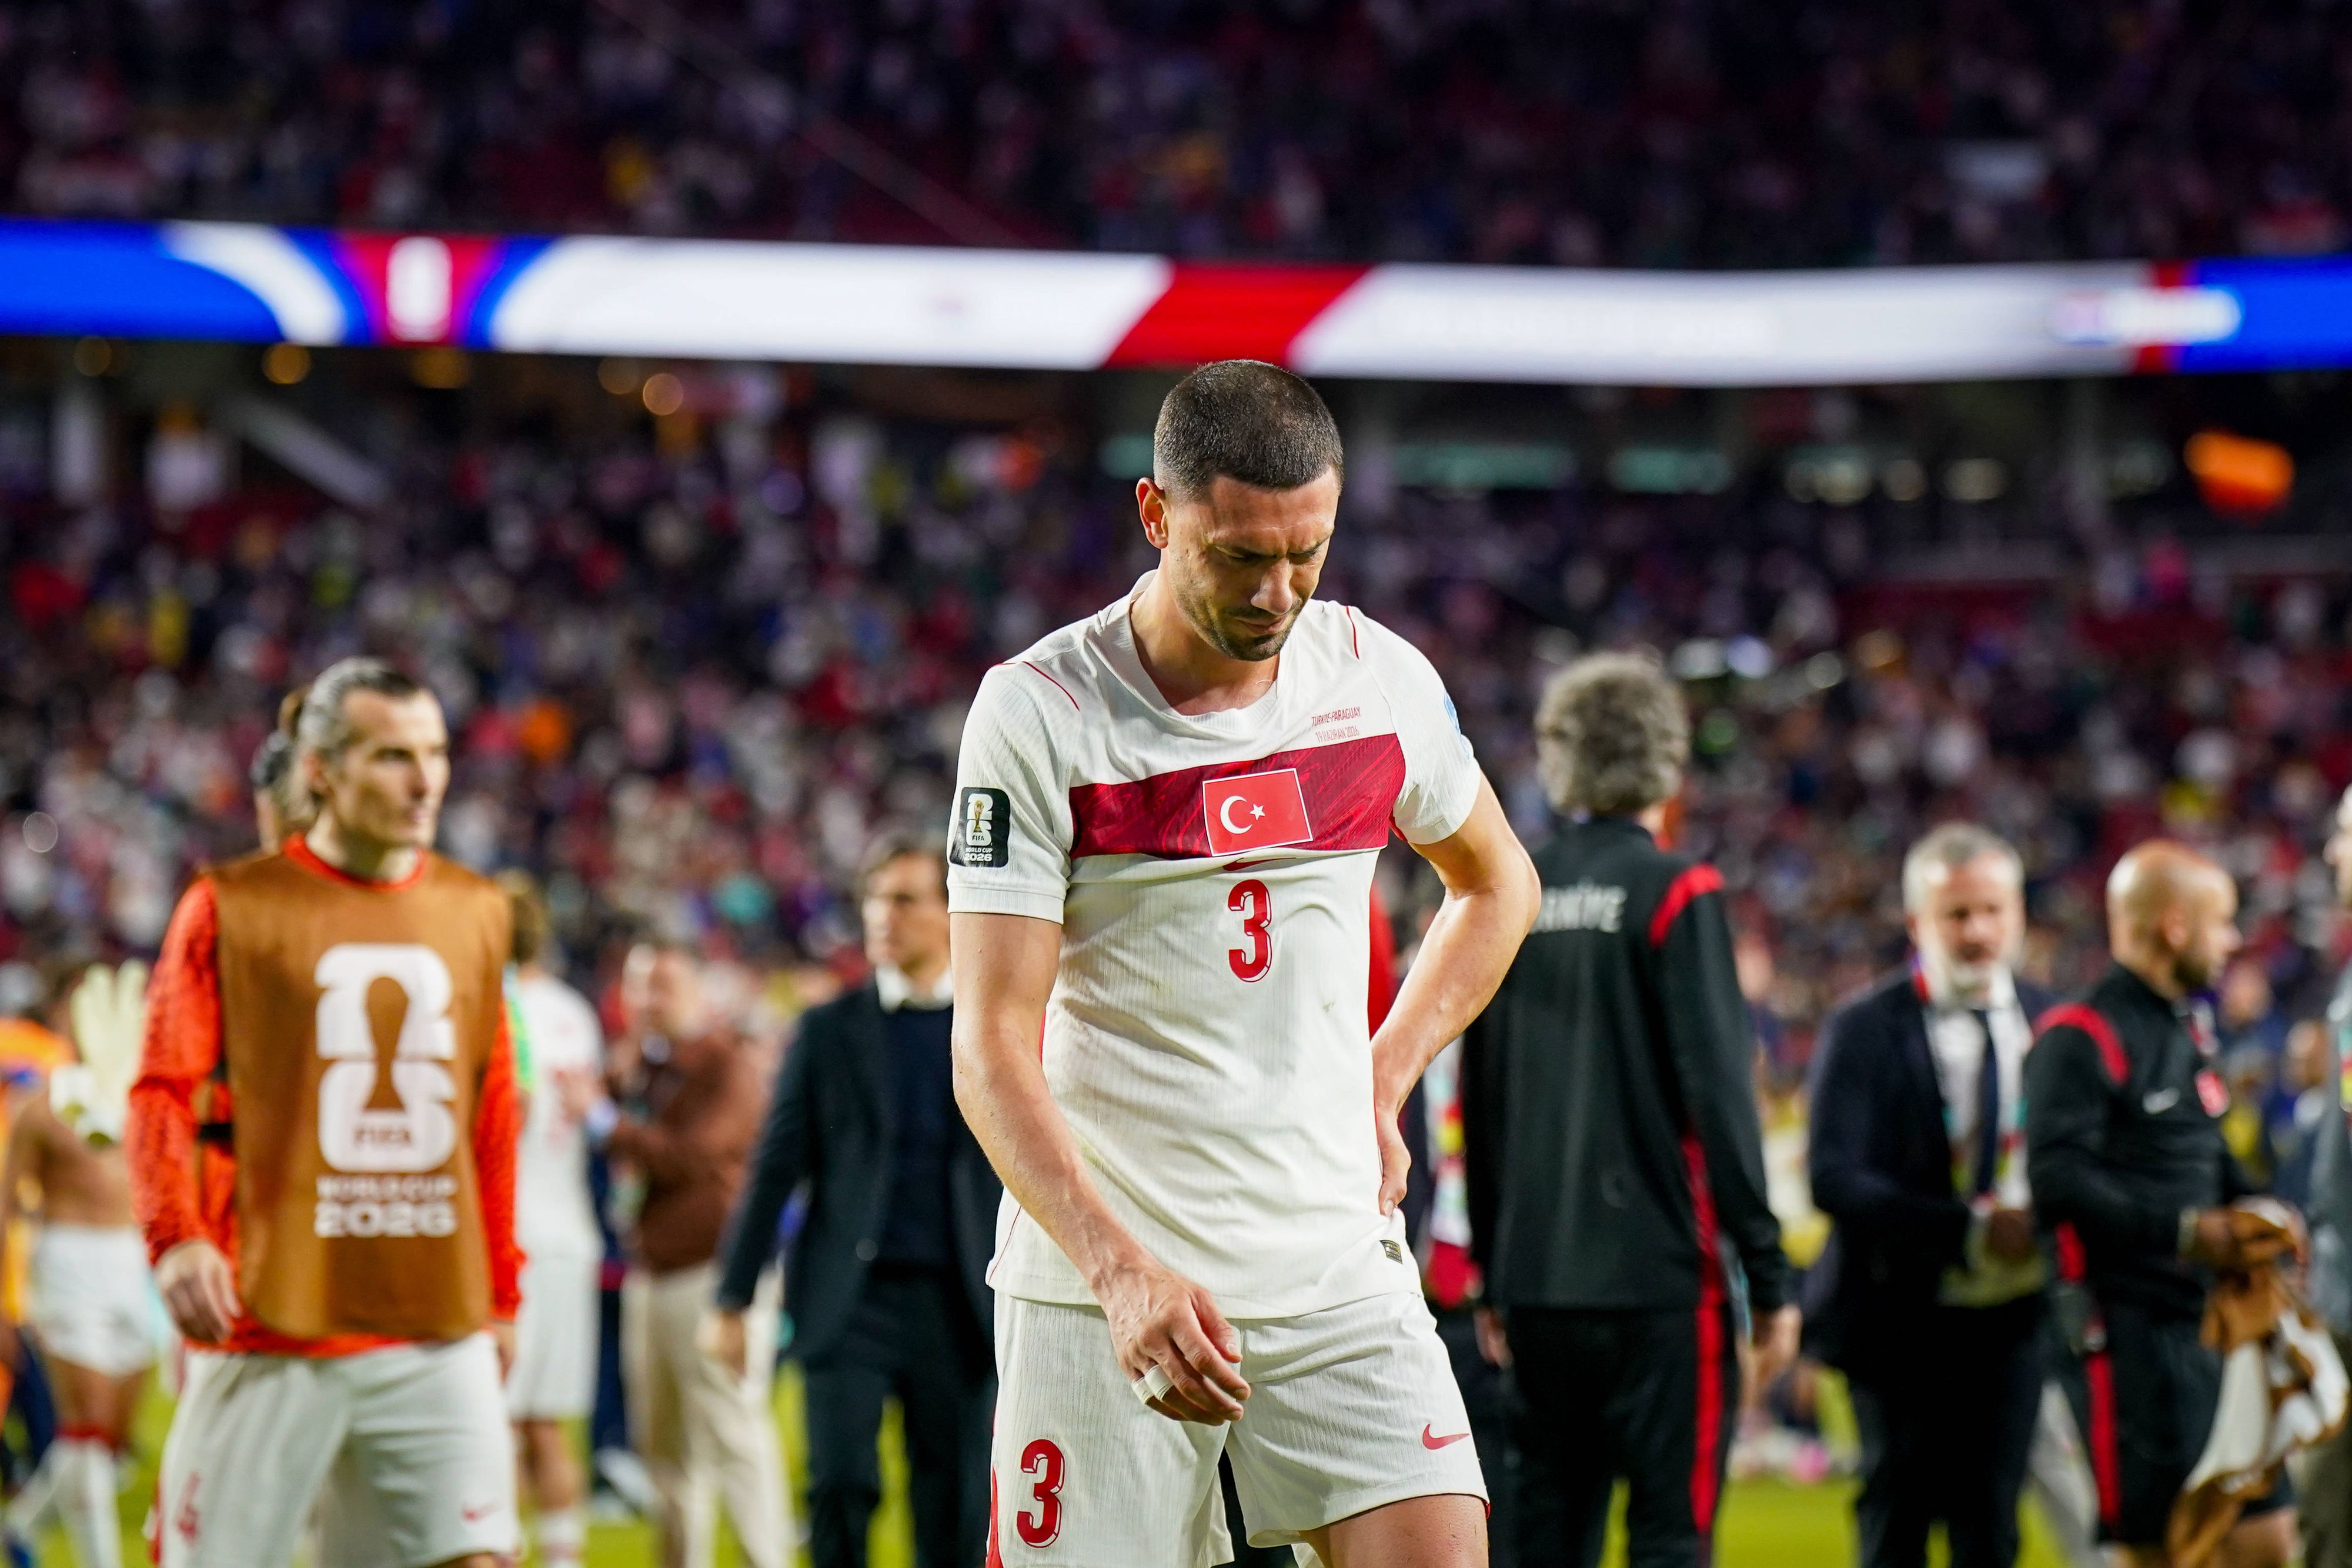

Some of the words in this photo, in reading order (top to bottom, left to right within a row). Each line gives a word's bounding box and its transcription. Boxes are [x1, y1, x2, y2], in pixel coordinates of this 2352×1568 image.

[964, 853, 993, 861] 2026
[1228, 879, 1272, 982] 3
[355, 1125, 413, 1146] FIFA
[315, 1201, 458, 1238] 2026
[1017, 1439, 1065, 1547] 3
